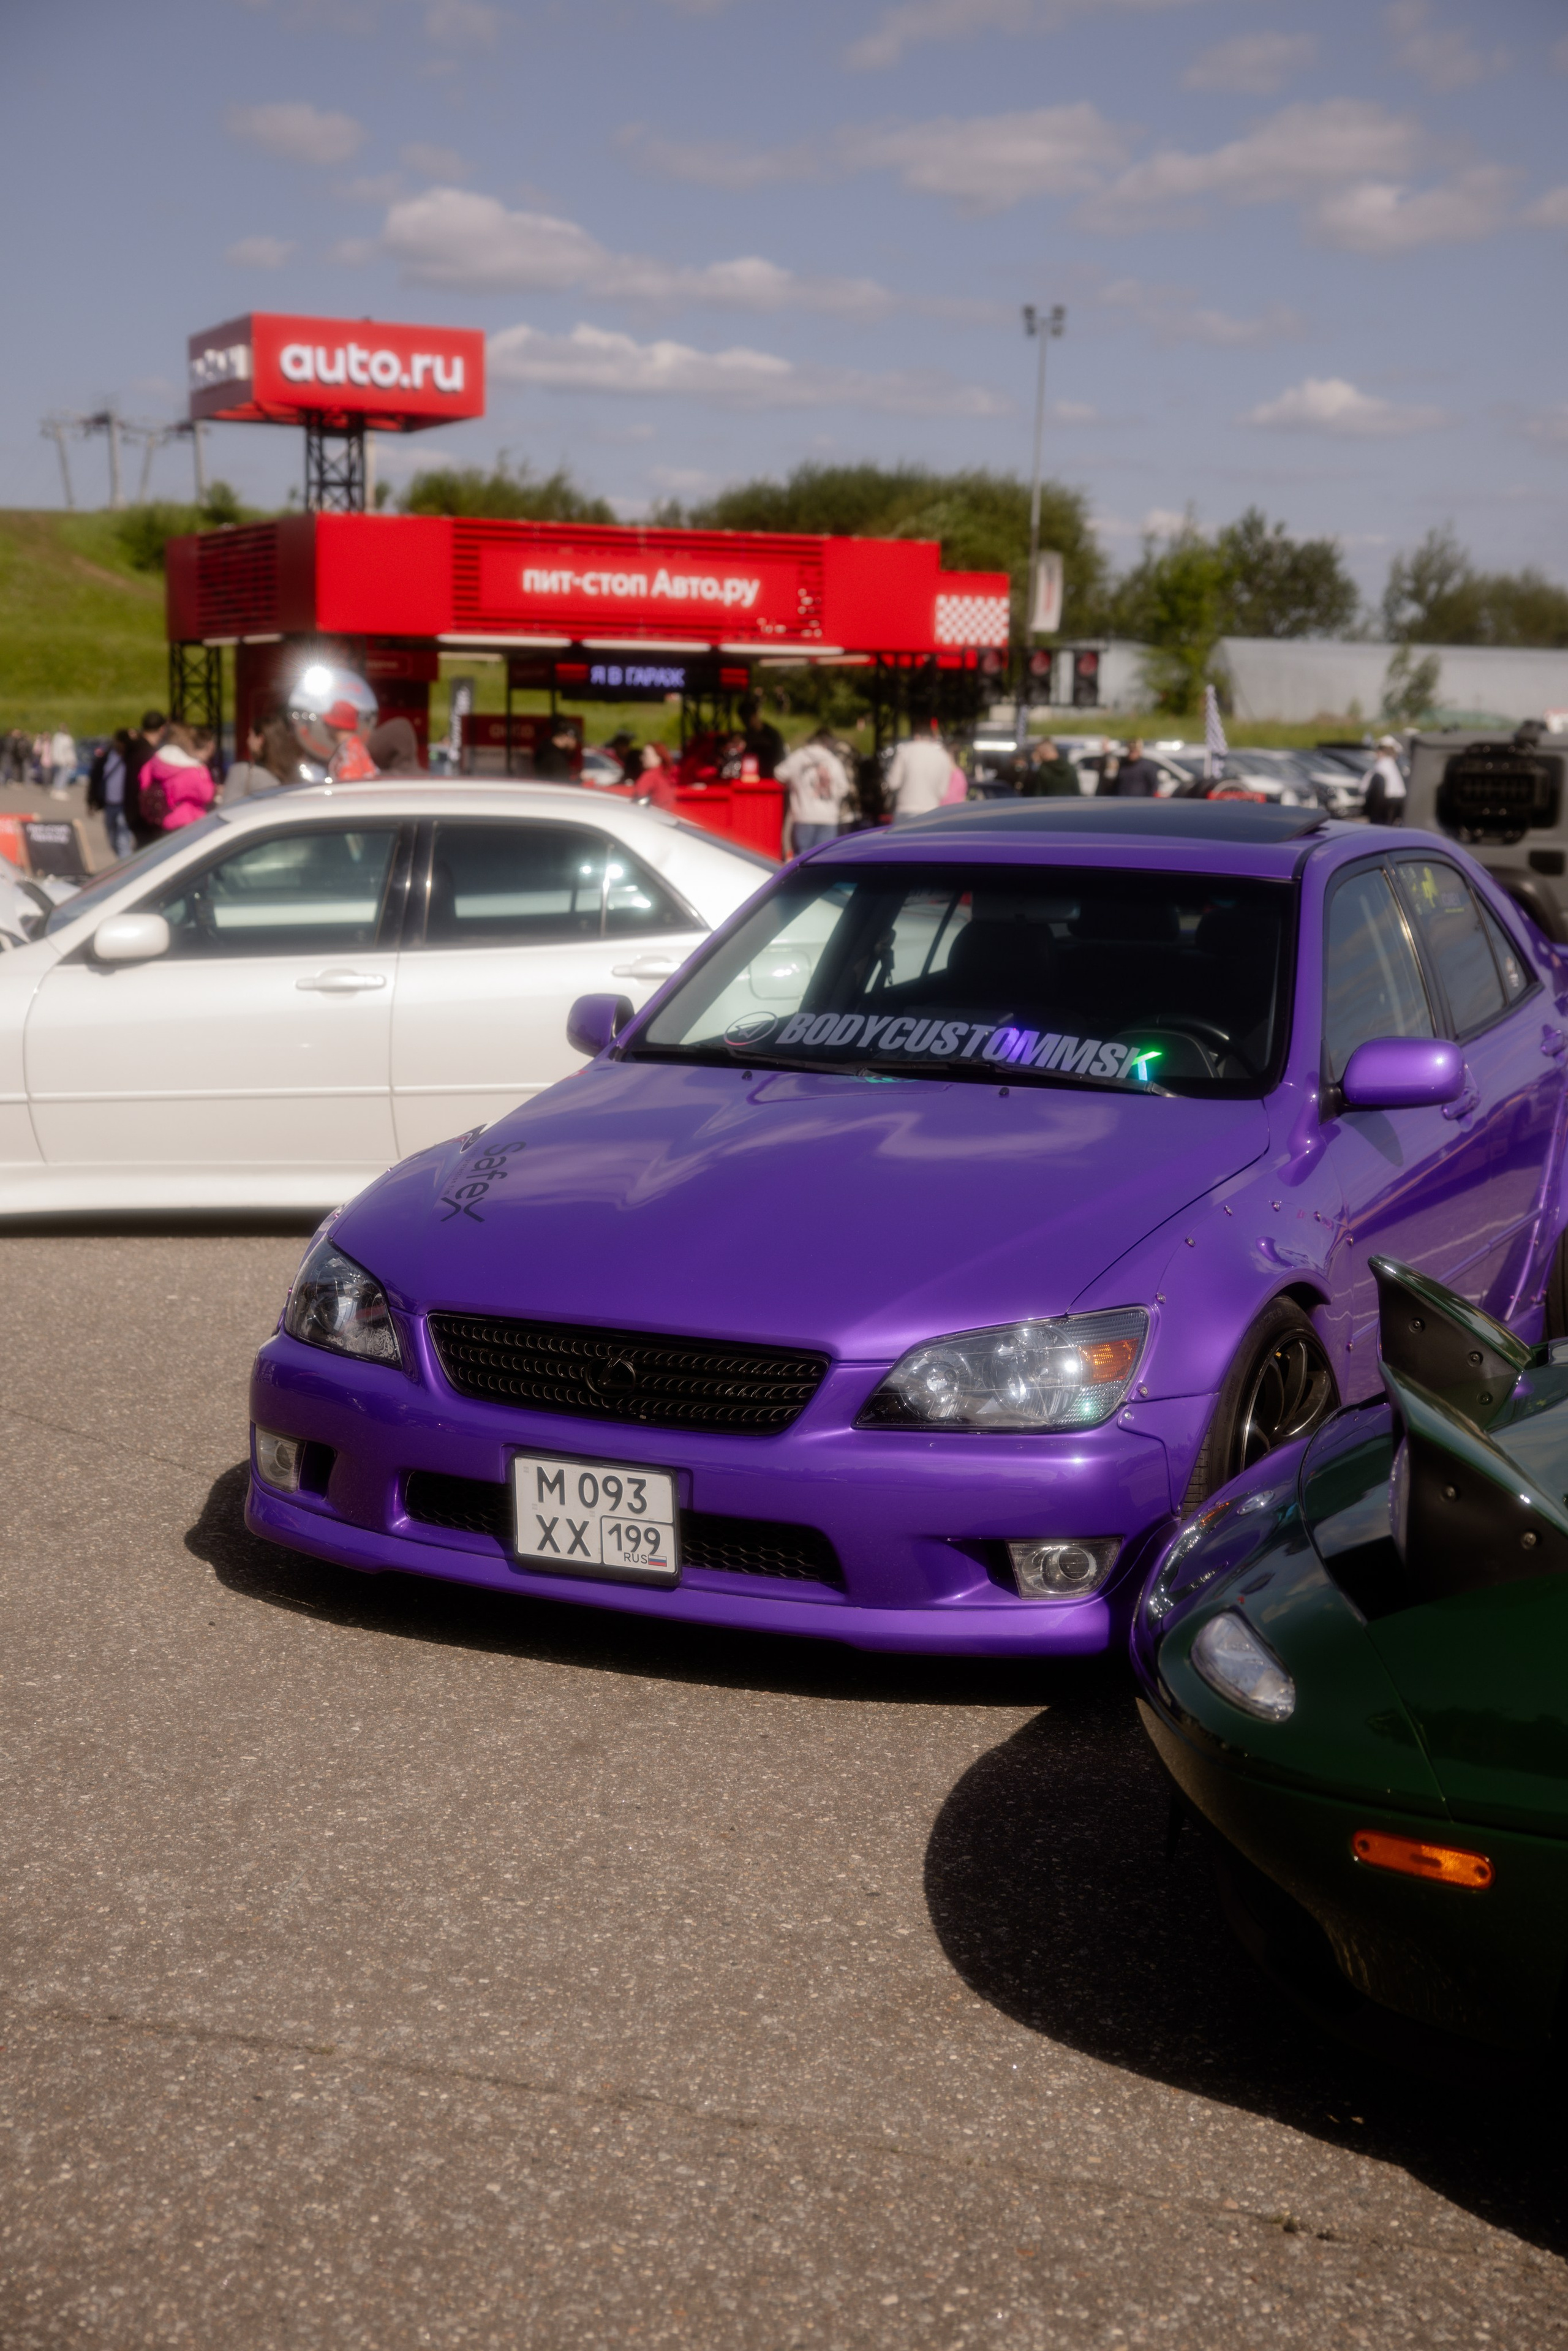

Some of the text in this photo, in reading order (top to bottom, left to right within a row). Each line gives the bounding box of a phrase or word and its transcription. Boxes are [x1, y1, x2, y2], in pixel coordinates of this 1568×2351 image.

[280, 343, 464, 392] auto.ru
[522, 568, 760, 608] пит-стоп Авто.ру
[776, 1012, 1162, 1081] BODYCUSTOMMSK
[578, 1473, 647, 1514] 093
[608, 1523, 661, 1555] 199
[624, 1552, 648, 1564] RUS
